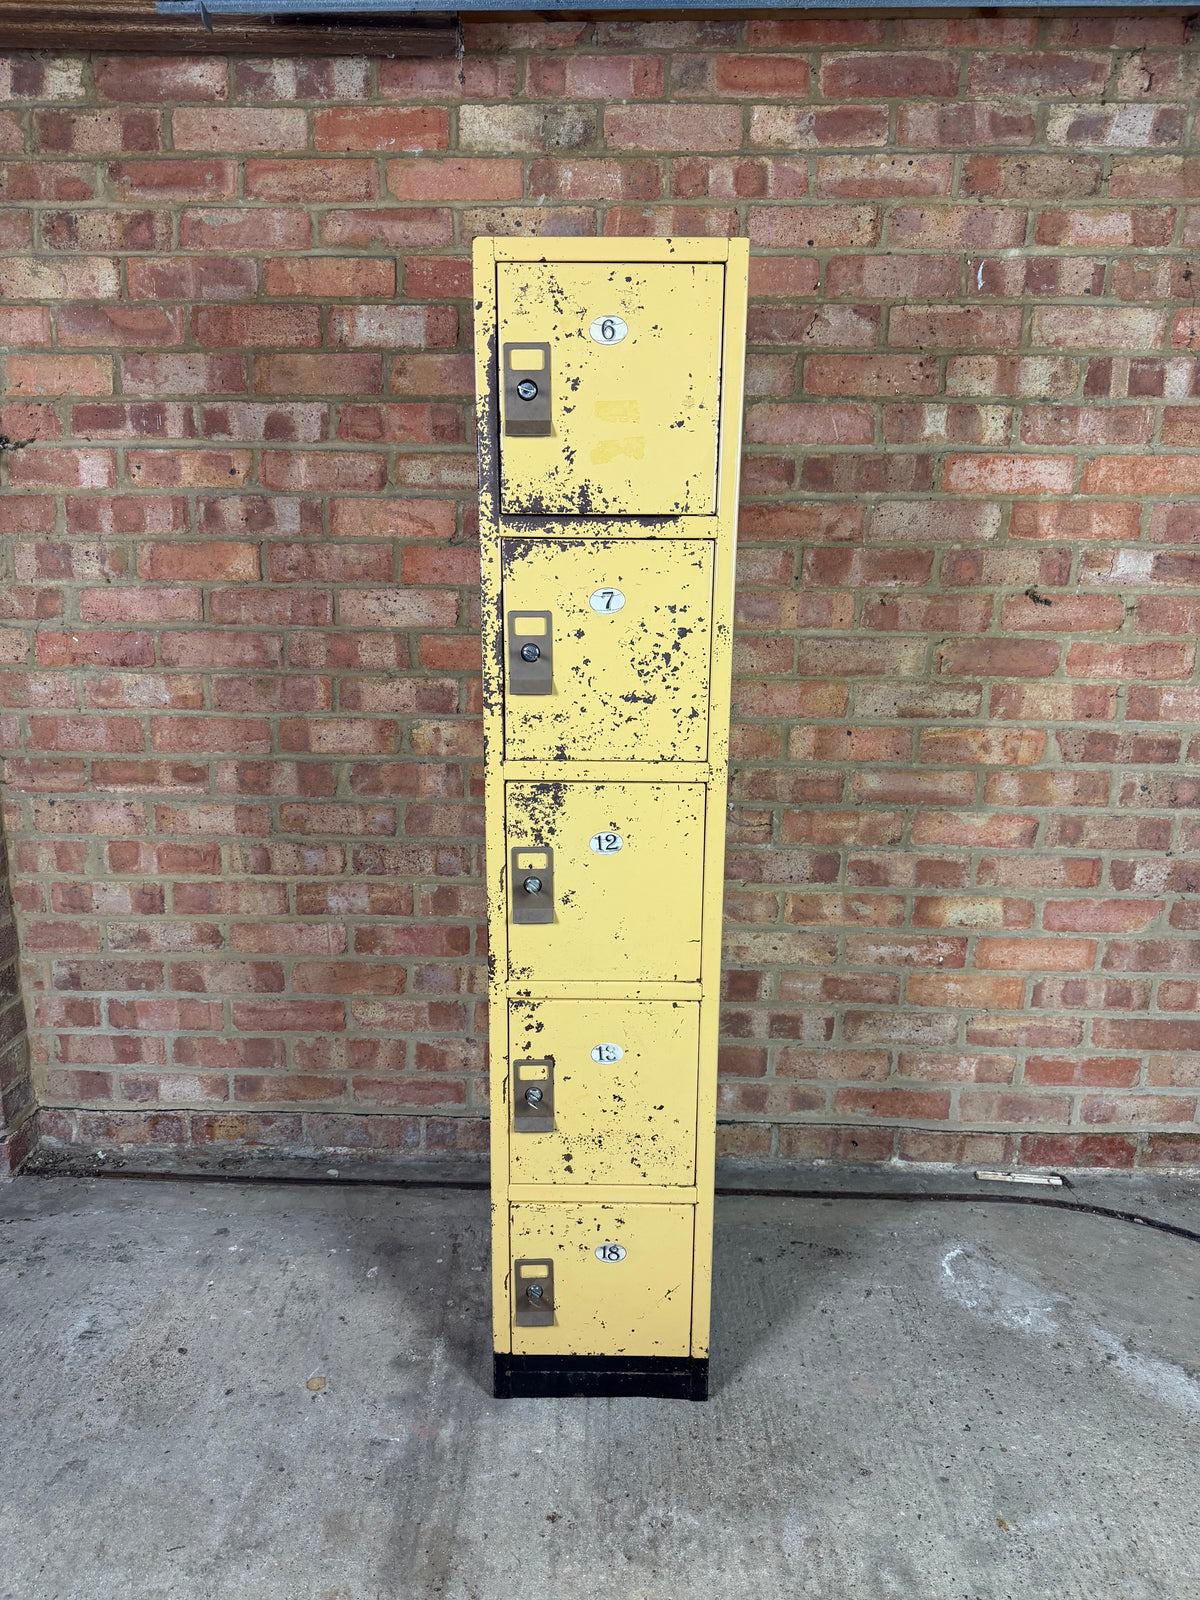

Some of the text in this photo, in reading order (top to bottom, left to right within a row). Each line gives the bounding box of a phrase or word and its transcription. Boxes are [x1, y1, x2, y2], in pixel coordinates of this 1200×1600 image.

[601, 319, 616, 340] 6
[602, 591, 614, 609] 7
[595, 834, 618, 851] 12
[600, 1245, 620, 1261] 18
